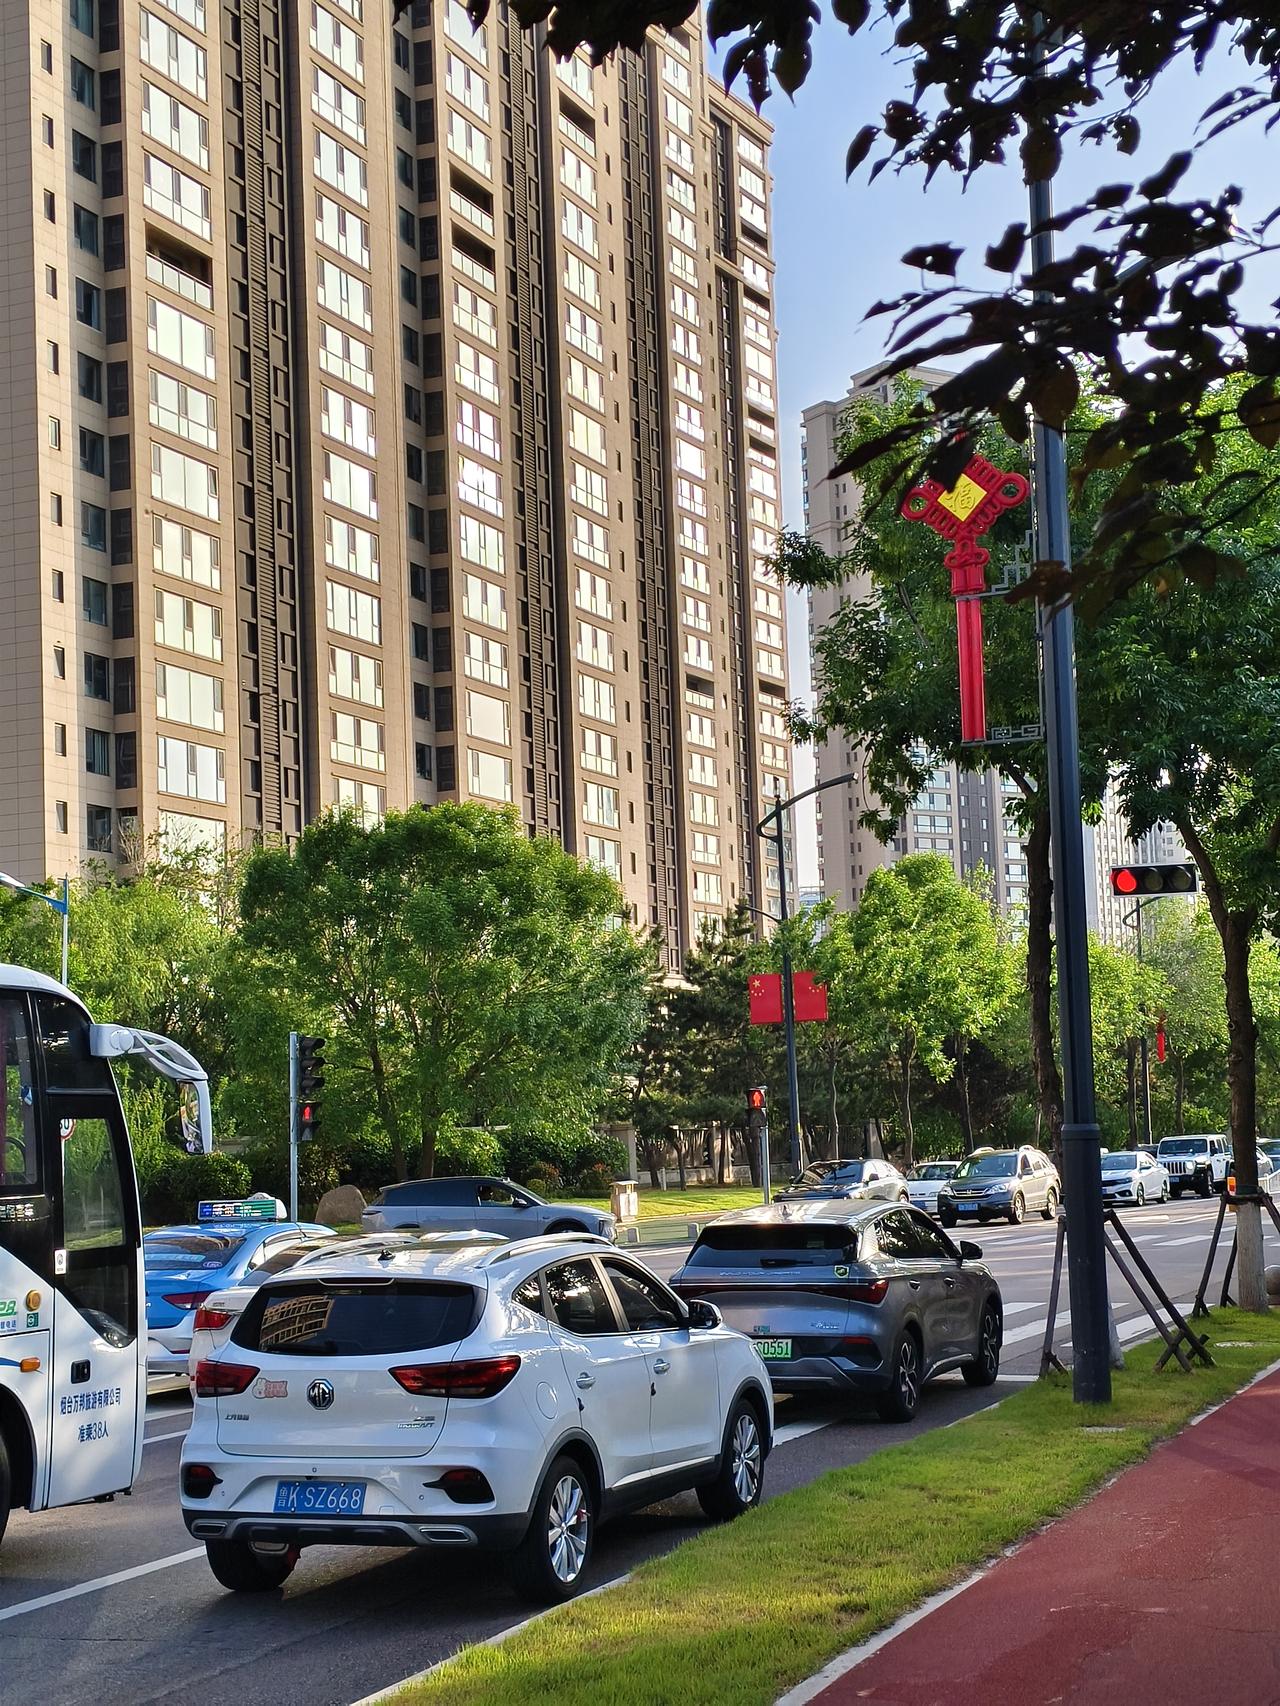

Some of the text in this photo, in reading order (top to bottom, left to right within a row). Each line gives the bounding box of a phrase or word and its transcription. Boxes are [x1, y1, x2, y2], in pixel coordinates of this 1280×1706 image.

[60, 1388, 121, 1415] 烟台万邦旅游有限公司
[309, 1382, 333, 1408] MG
[78, 1421, 109, 1442] 准乘38人
